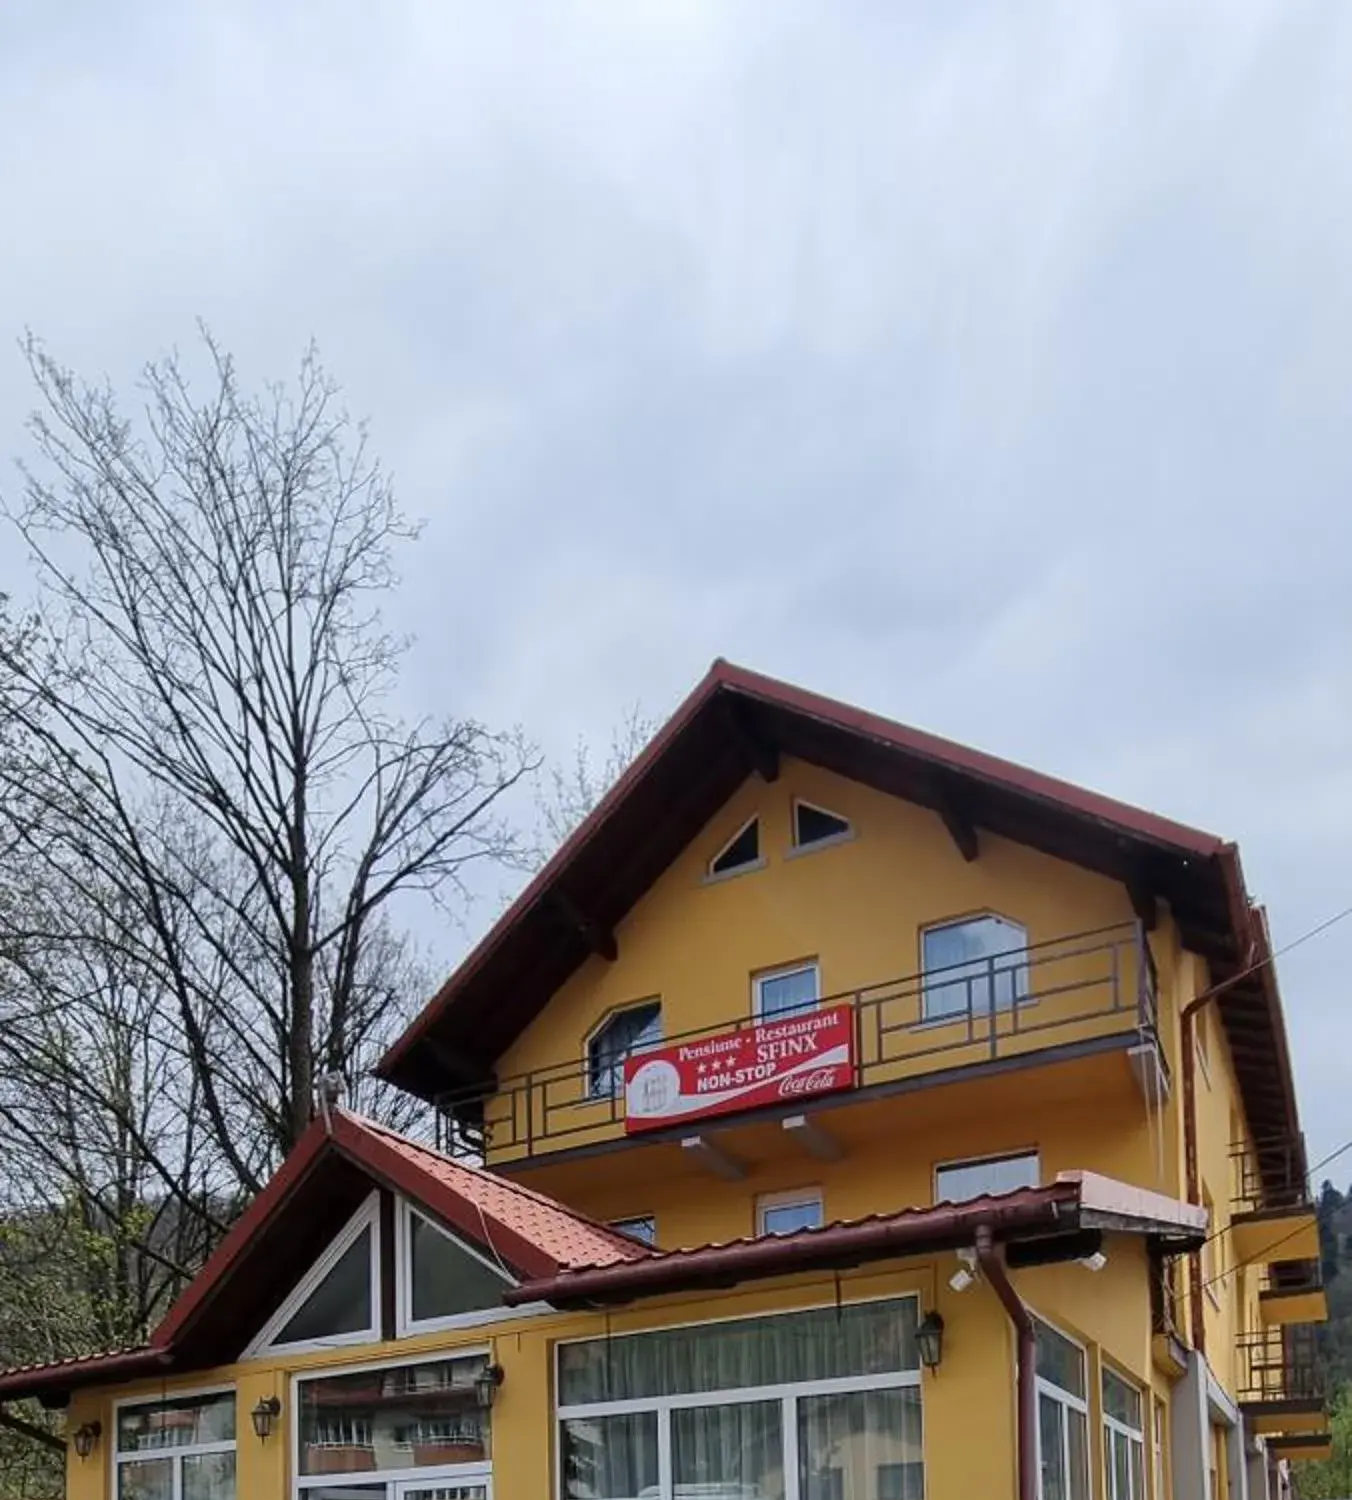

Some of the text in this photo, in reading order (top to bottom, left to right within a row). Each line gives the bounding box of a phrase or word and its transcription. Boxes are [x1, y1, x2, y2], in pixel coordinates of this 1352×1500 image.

[755, 1012, 839, 1043] Restaurant
[757, 1032, 818, 1063] SFINX
[697, 1062, 776, 1092] NON-STOP
